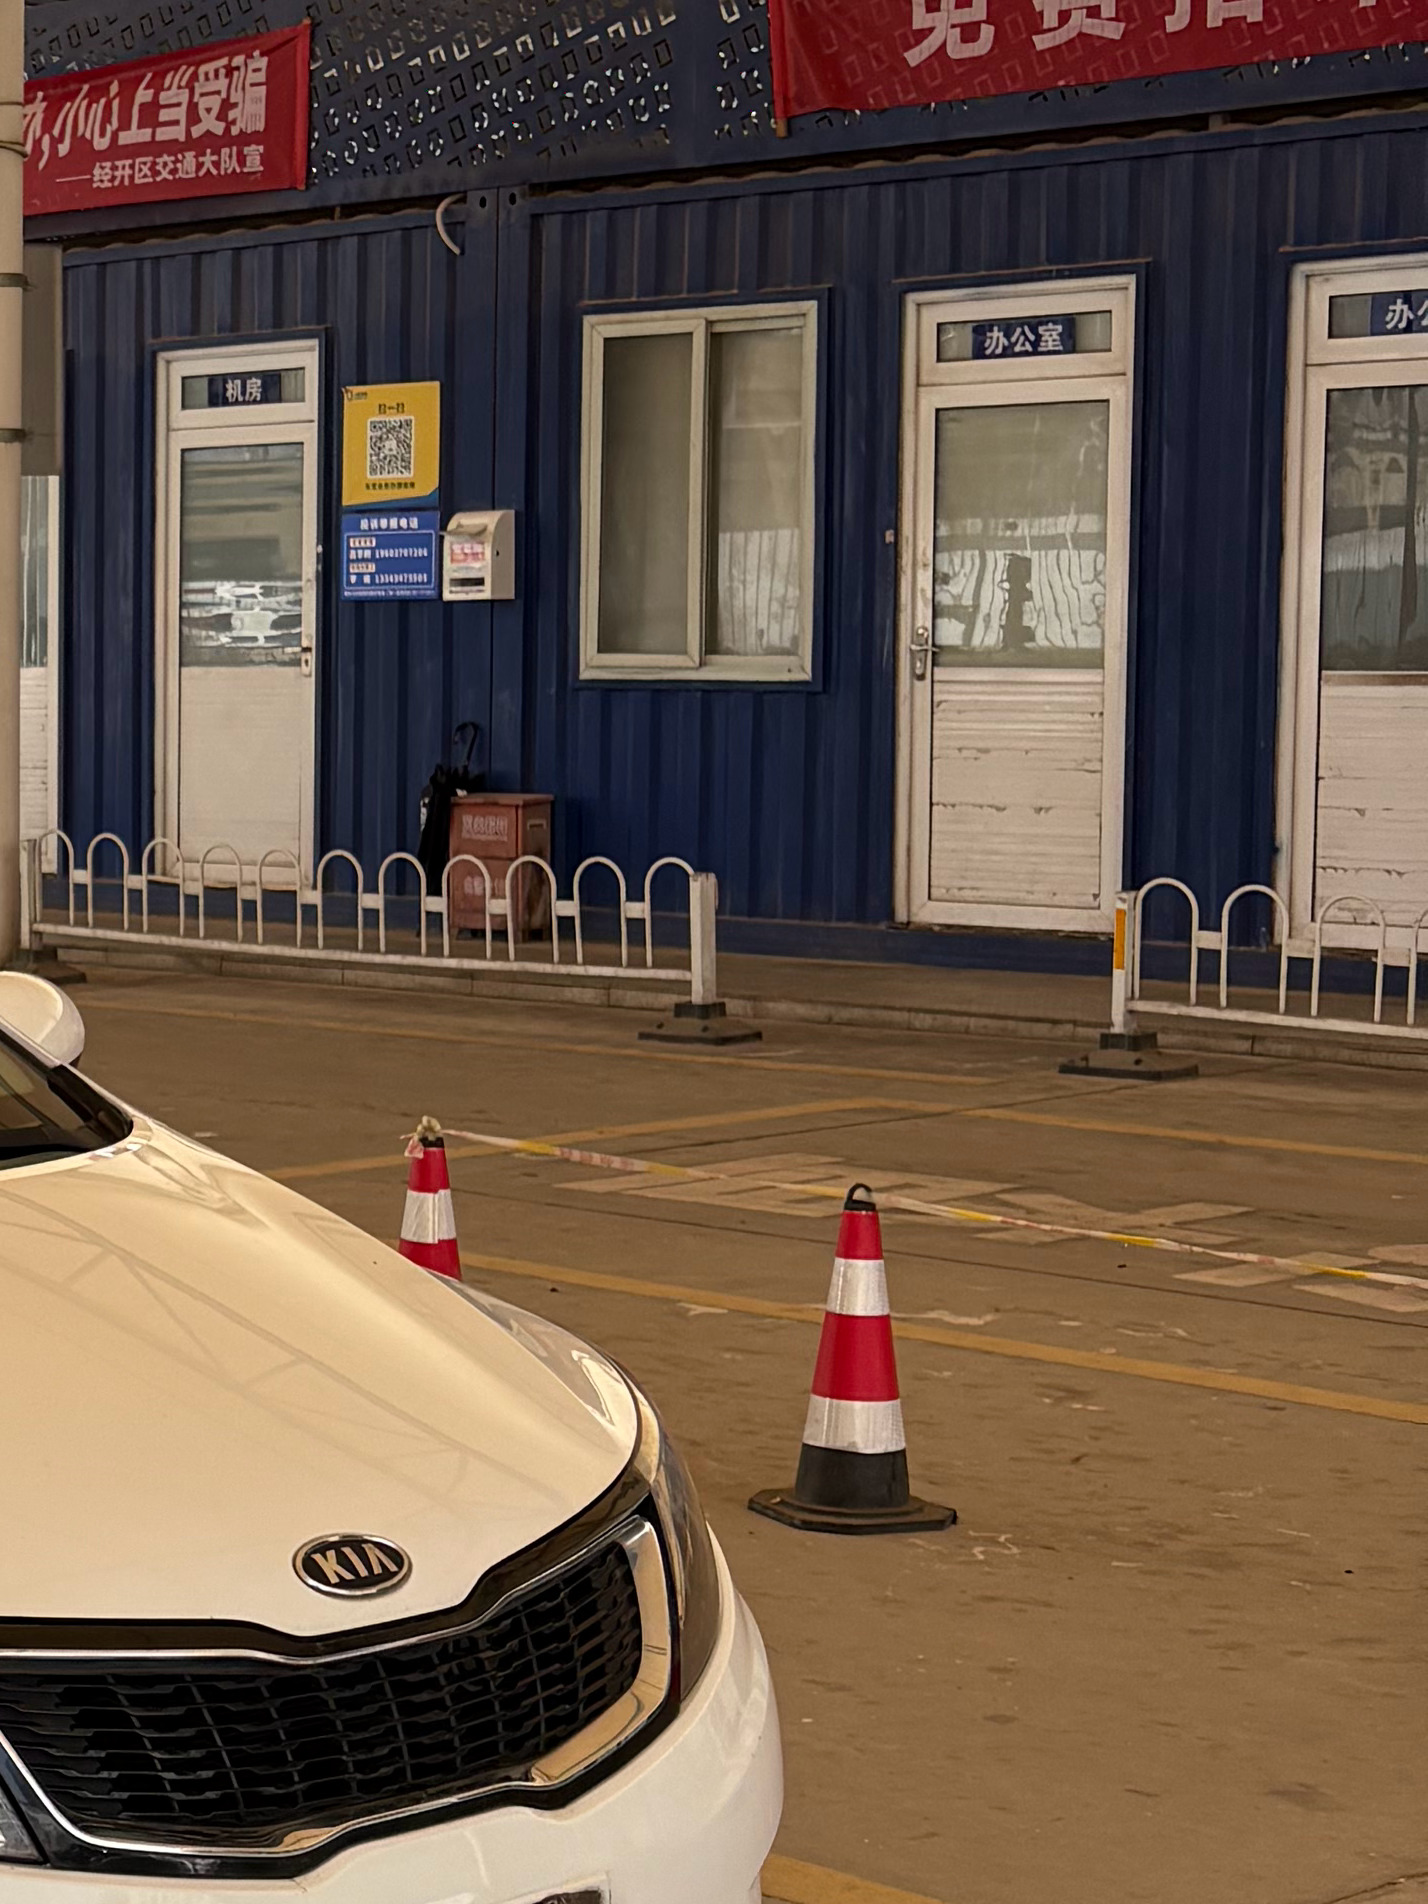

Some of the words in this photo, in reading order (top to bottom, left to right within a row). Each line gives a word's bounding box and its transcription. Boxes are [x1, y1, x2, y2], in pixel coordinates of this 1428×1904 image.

[984, 322, 1063, 356] 办公室
[225, 376, 262, 402] 机房
[310, 1543, 399, 1585] KIA
